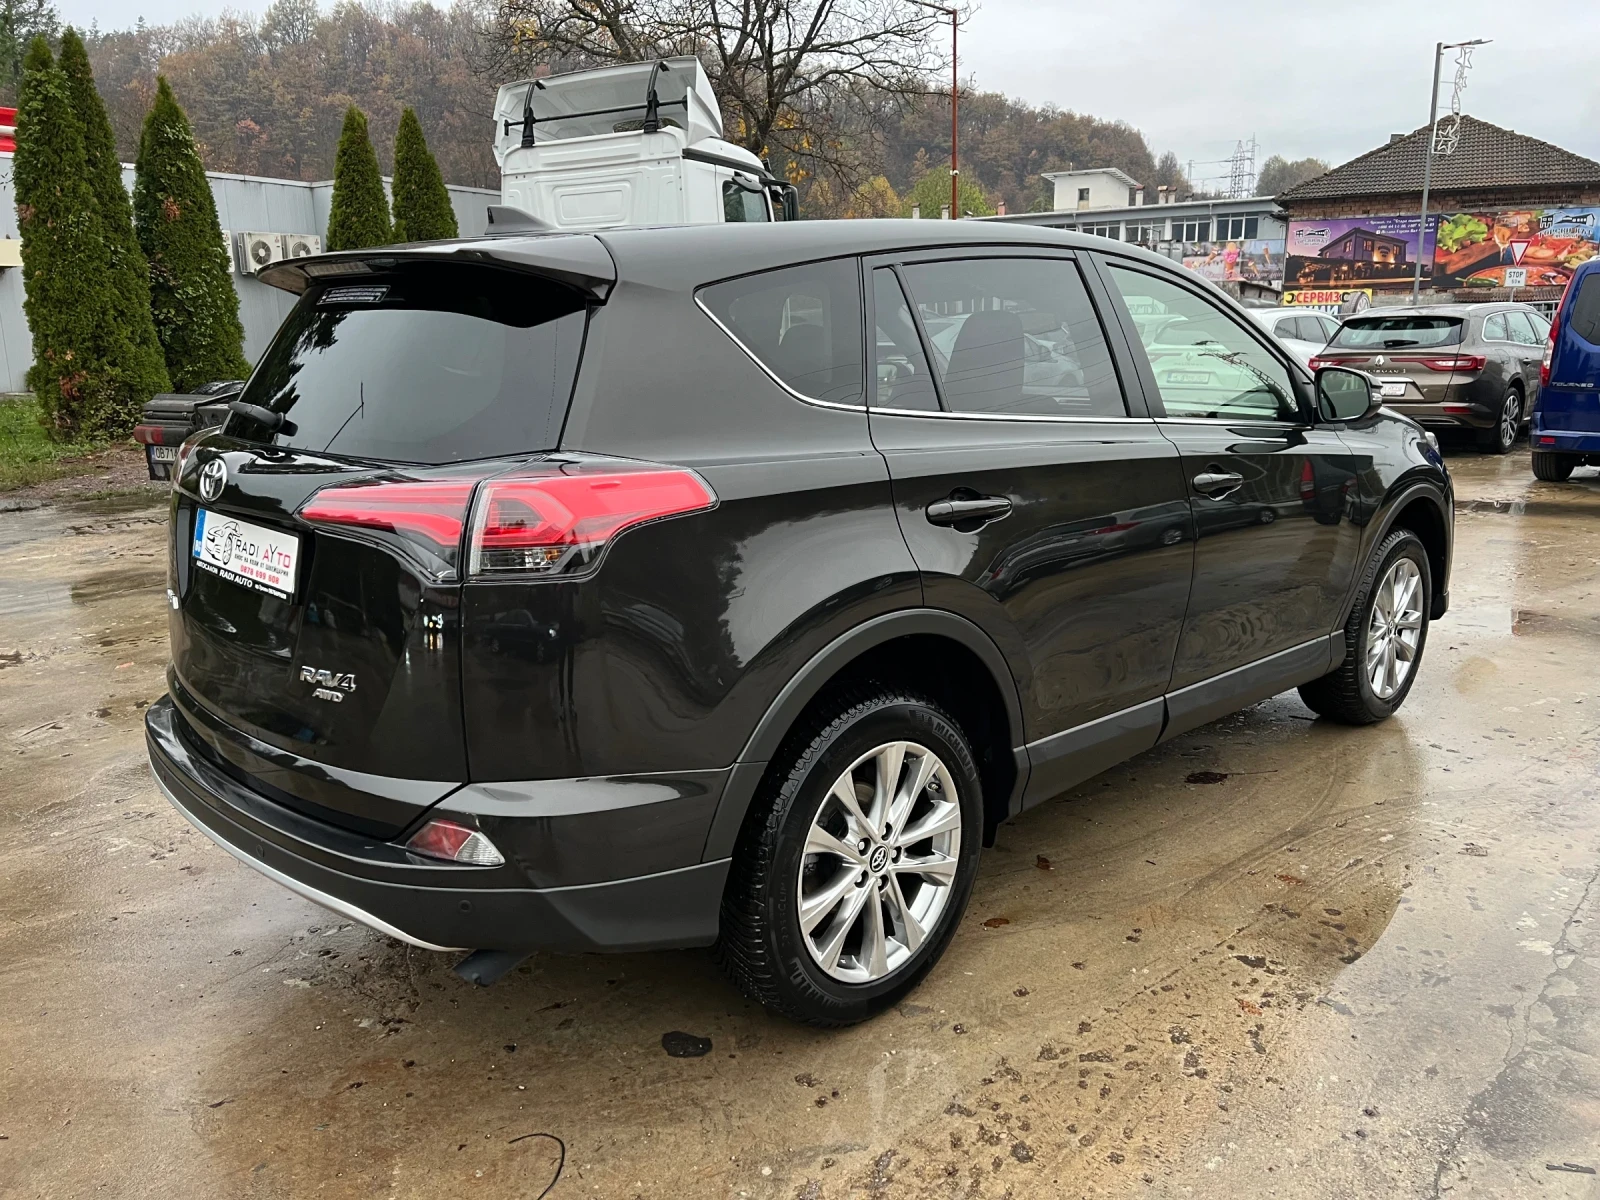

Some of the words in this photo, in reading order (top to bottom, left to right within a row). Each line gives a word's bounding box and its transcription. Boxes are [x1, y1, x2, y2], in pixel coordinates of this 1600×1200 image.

[1296, 291, 1341, 304] СЕРВИЗ
[235, 539, 259, 558] RADI
[219, 569, 235, 582] RADI
[234, 575, 253, 588] AUTO
[300, 665, 357, 692] RAV4
[311, 688, 345, 703] AWD
